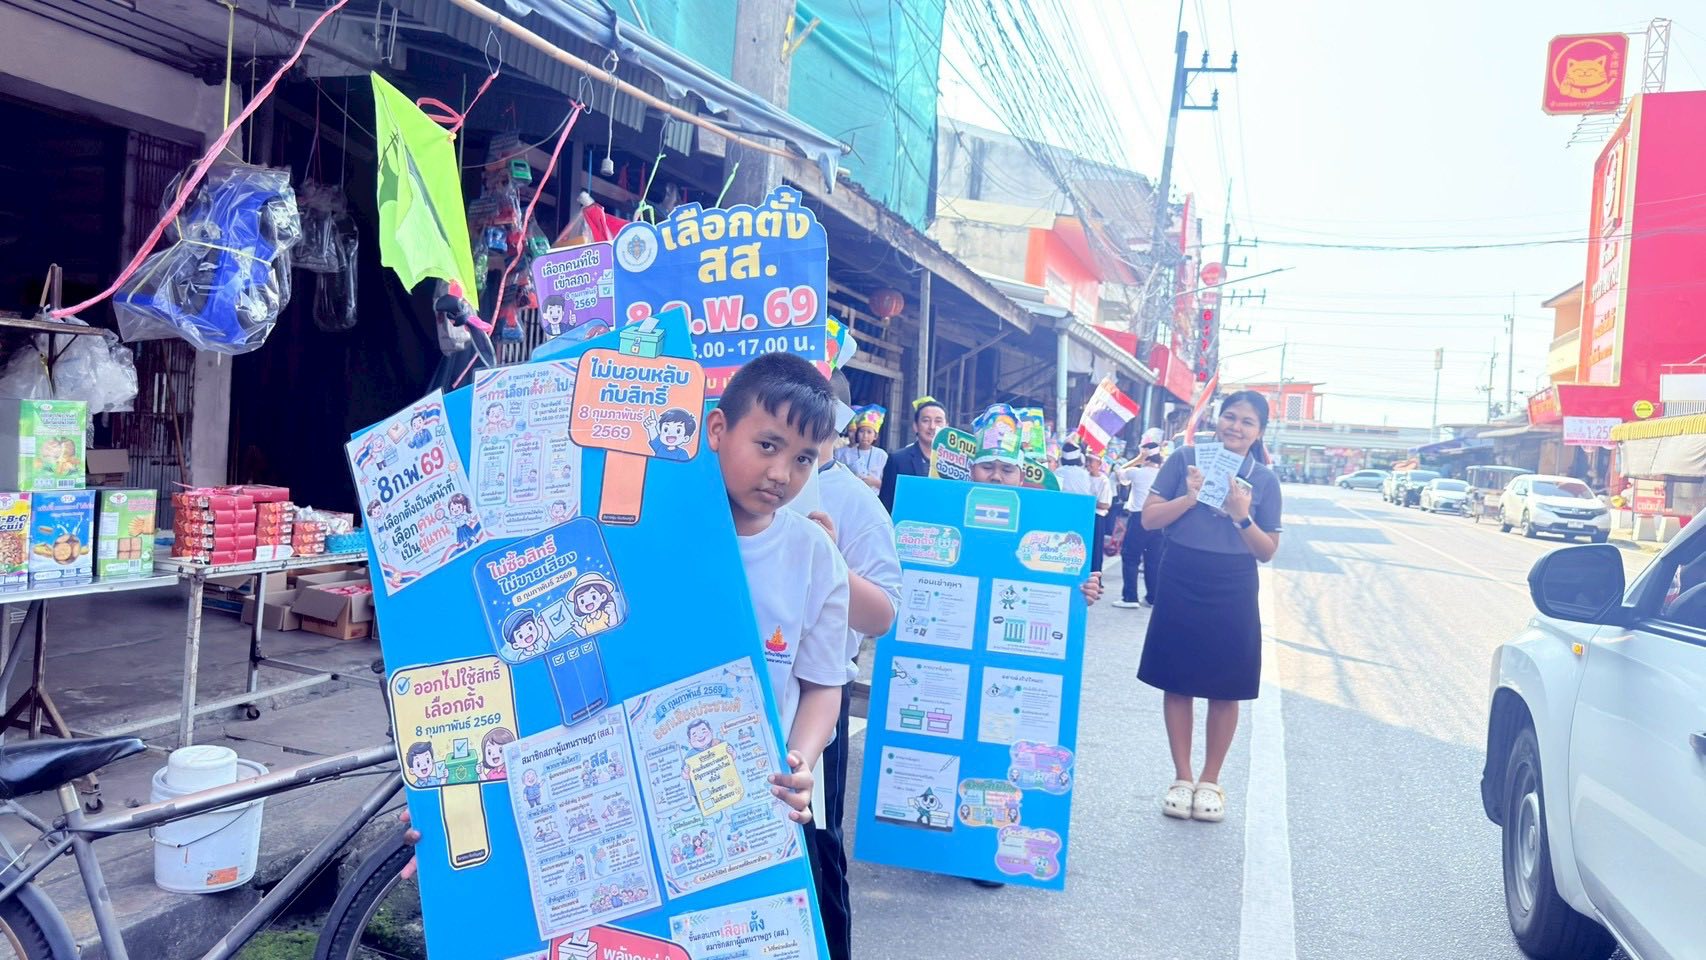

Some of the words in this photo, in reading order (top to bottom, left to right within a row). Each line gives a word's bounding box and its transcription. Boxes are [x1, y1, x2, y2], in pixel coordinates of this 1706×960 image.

[661, 191, 810, 251] เลือกตั้ง
[542, 250, 599, 277] เลือกคนที่ใช่
[697, 242, 778, 283] สส.
[554, 273, 590, 290] เข้าสภา
[574, 296, 597, 309] 2569
[764, 287, 818, 327] 69
[794, 334, 816, 352] น.
[591, 357, 690, 385] ไม่นอนหลับ
[600, 382, 669, 405] ทับสิทธิ์
[579, 405, 590, 419] 8
[592, 407, 644, 422] กุมภาพันธ์
[592, 424, 631, 439] 2569
[949, 433, 956, 445] 8
[383, 473, 456, 531] เลือกตั้งเป็นหน้าที่
[0, 521, 24, 531] cuit
[401, 524, 451, 561] เป็นผู้แทน
[488, 535, 556, 580] ไม่ซื้อสิทธิ์
[499, 552, 577, 595] ไม่ขายเสียง
[516, 595, 522, 603] 8
[523, 580, 555, 601] กุมภาพันธ์
[556, 570, 573, 586] 2569
[414, 661, 501, 696] ออกไปใช้สิทธิ์
[703, 685, 723, 696] 2569
[424, 686, 485, 719] เลือกตั้ง
[415, 725, 423, 737] 8
[425, 716, 471, 738] กุมภาพันธ์
[474, 712, 502, 728] 2569
[521, 732, 597, 765] สมาชิกสภาผู้แทนราษฎร
